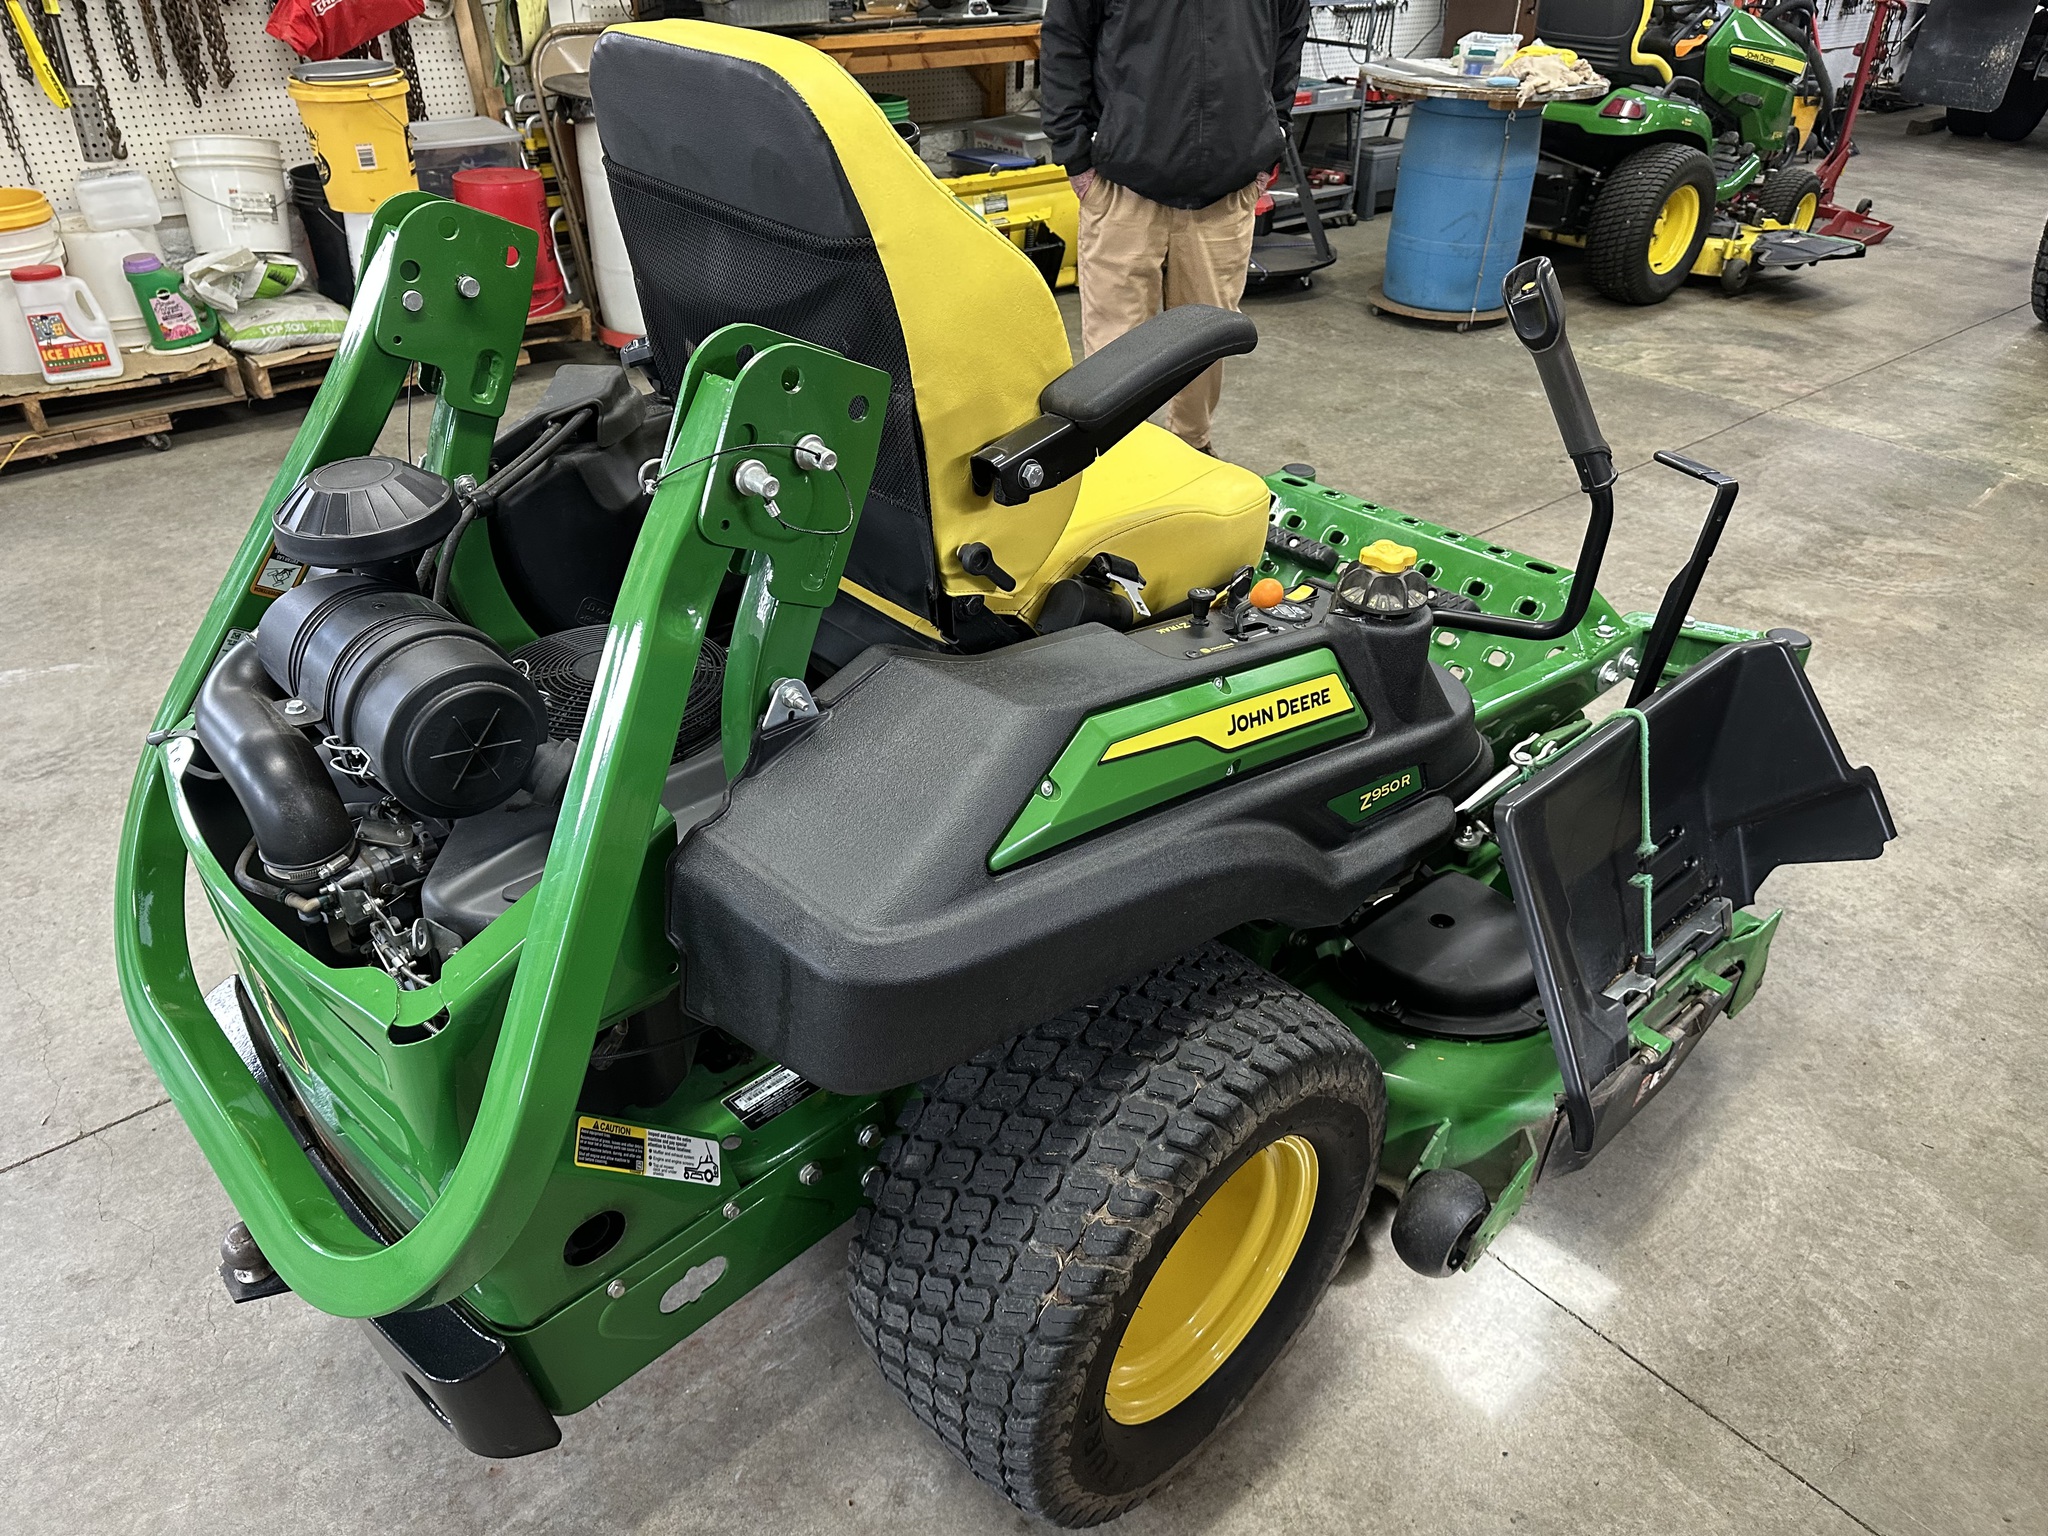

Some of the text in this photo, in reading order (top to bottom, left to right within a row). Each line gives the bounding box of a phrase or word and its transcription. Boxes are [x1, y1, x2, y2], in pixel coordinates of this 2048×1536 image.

[1745, 50, 1775, 64] JOHN DEERE
[259, 324, 283, 336] TOP
[41, 348, 64, 361] ICE
[68, 343, 104, 359] MELT
[1156, 622, 1192, 634] ZTRAK
[1227, 687, 1331, 736] JOHN DEERE
[1359, 773, 1412, 812] Z950R
[600, 1122, 630, 1135] CAUTION
